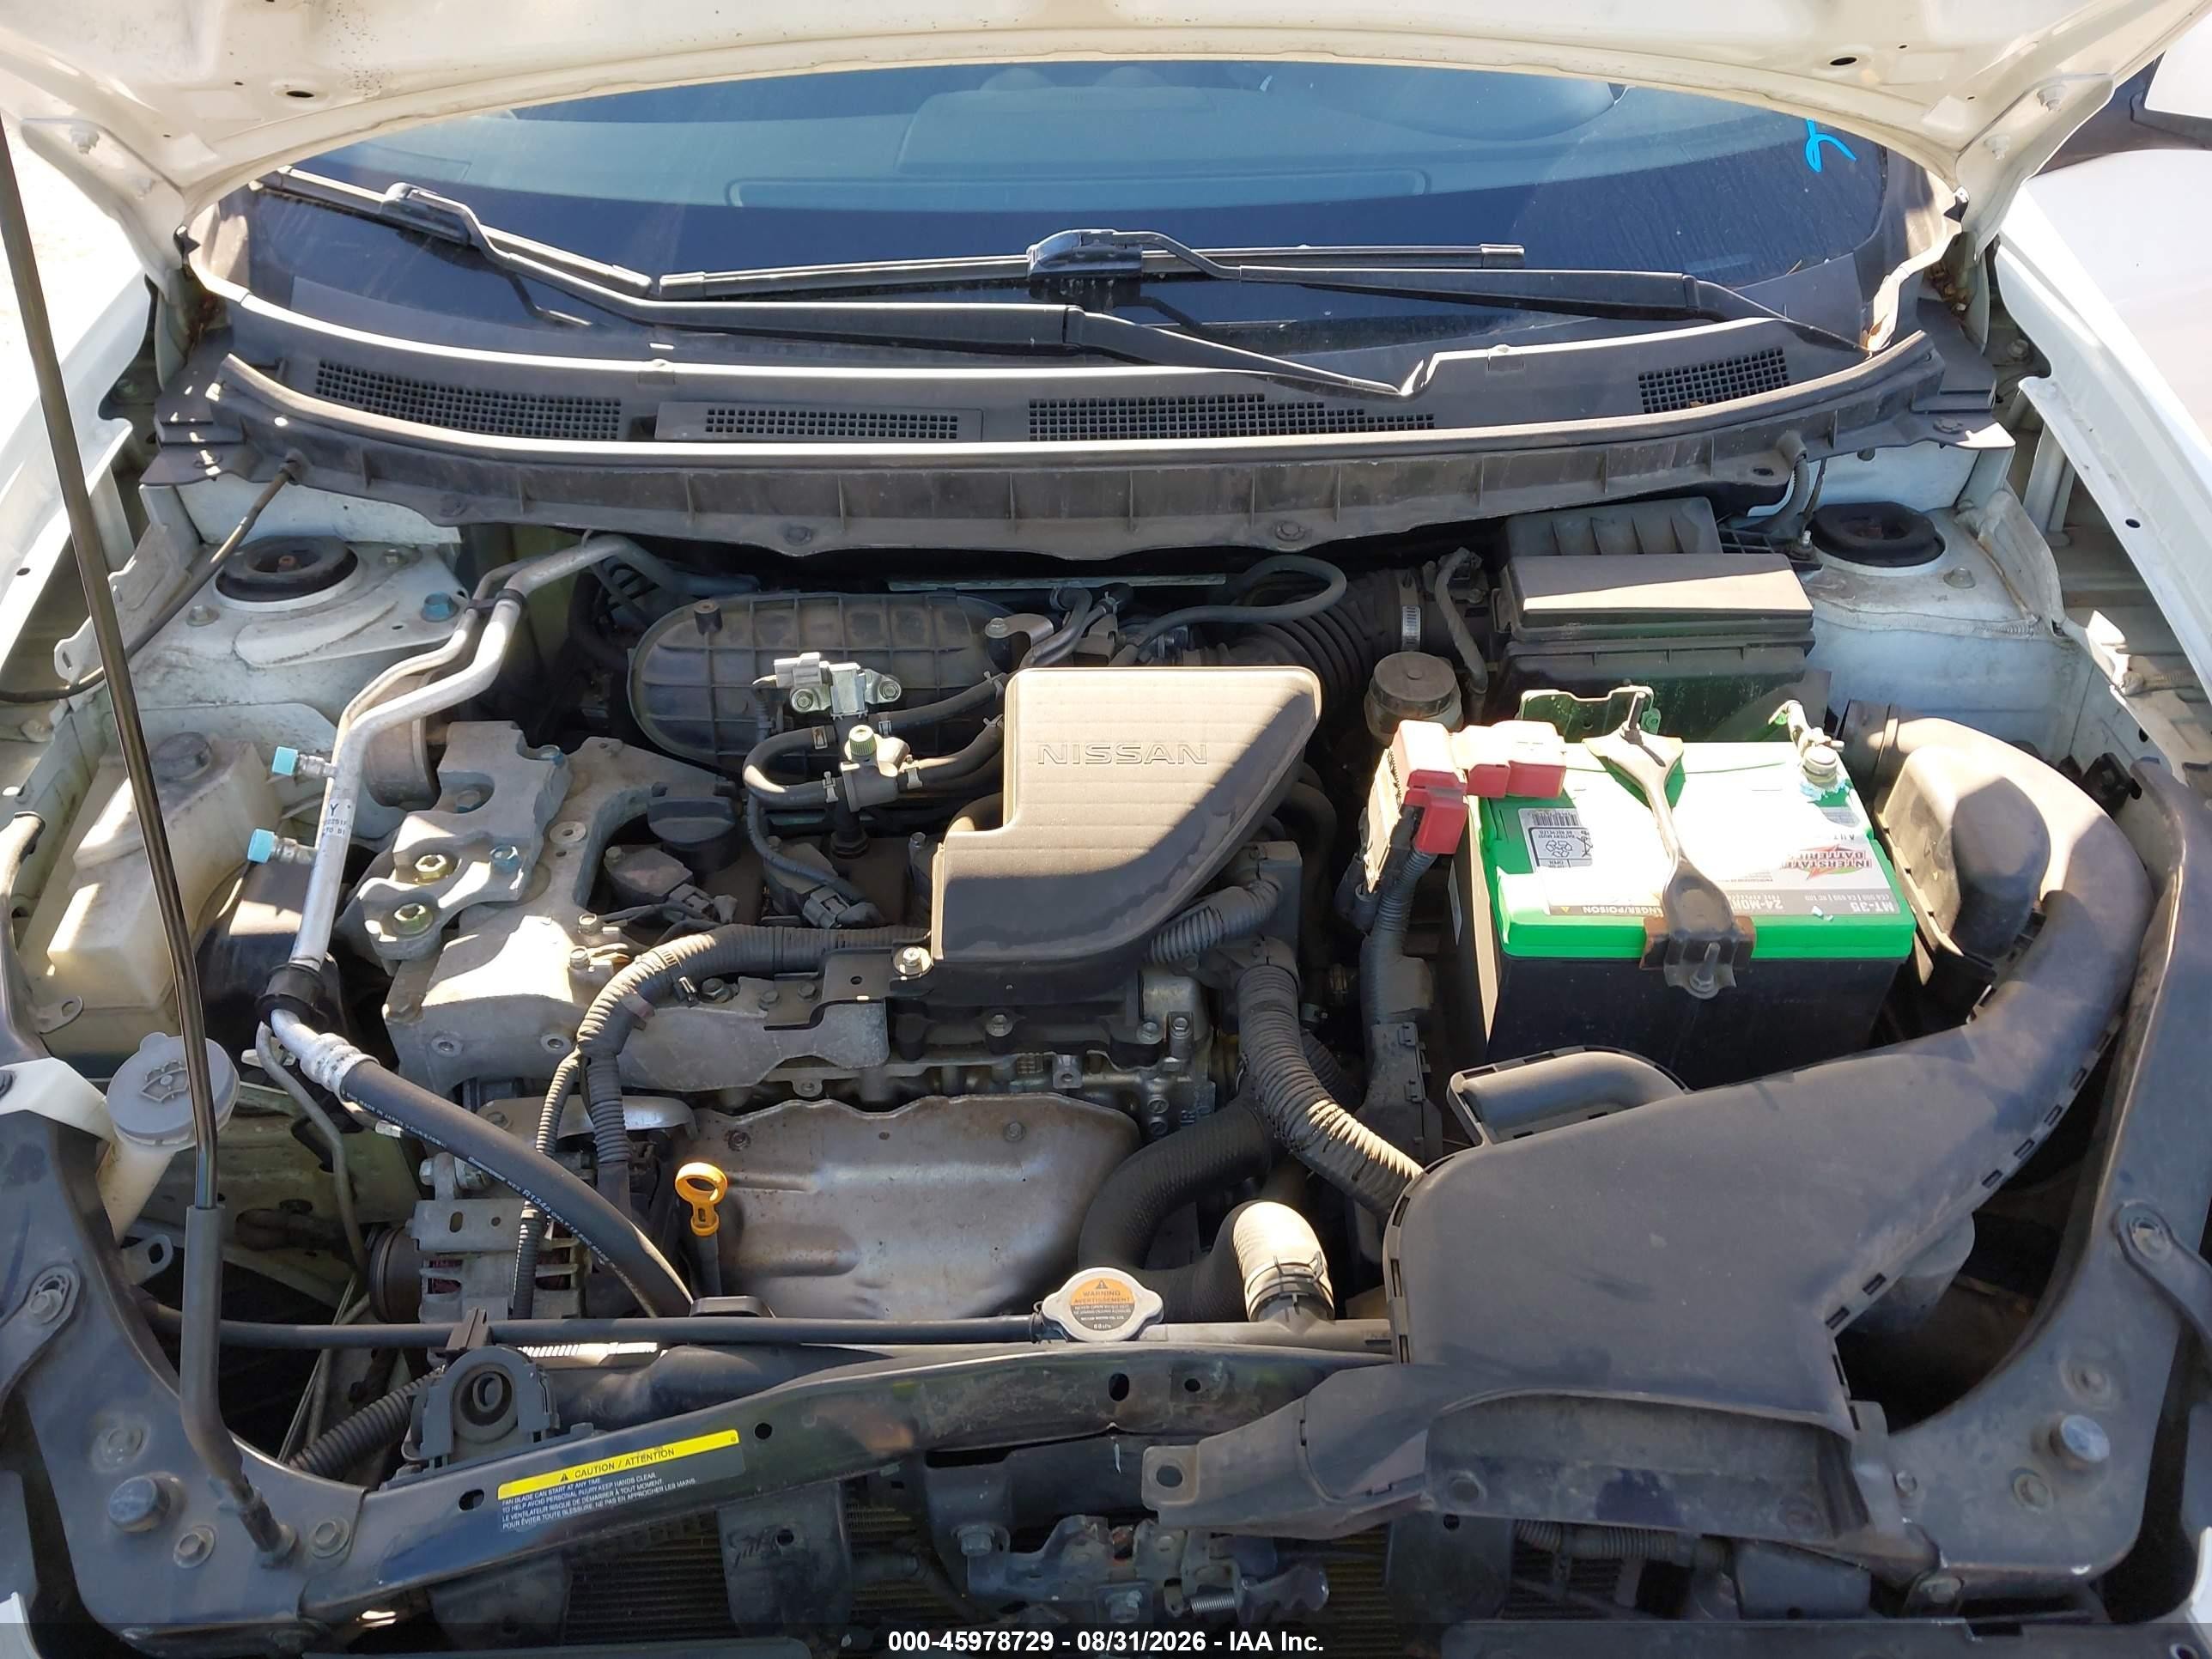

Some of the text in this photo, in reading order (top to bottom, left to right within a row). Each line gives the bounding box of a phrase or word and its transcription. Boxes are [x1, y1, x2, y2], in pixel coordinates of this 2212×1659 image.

[1037, 743, 1208, 764] NISSAN
[1582, 906, 1663, 915] ANGER/POISON
[1732, 899, 1784, 909] 24-MON
[1850, 901, 1895, 912] MT-35
[575, 1462, 614, 1478] CAUTION
[625, 1448, 673, 1466] ATTENTION
[512, 1502, 526, 1511] HELP
[528, 1498, 544, 1508] AVOID
[547, 1491, 576, 1503] PERSONAL
[614, 1476, 634, 1487] HANDS
[535, 1490, 546, 1498] CAN
[549, 1486, 565, 1495] START
[575, 1480, 586, 1489] ANY
[502, 1520, 519, 1528] POUR
[542, 1510, 560, 1521] TOUTE
[605, 1497, 616, 1505] PAS
[627, 1485, 663, 1499] APPROCHER
[511, 1505, 547, 1520] VENTILATEUR
[550, 1500, 569, 1511] RISQUE
[621, 1485, 635, 1494] TOUT
